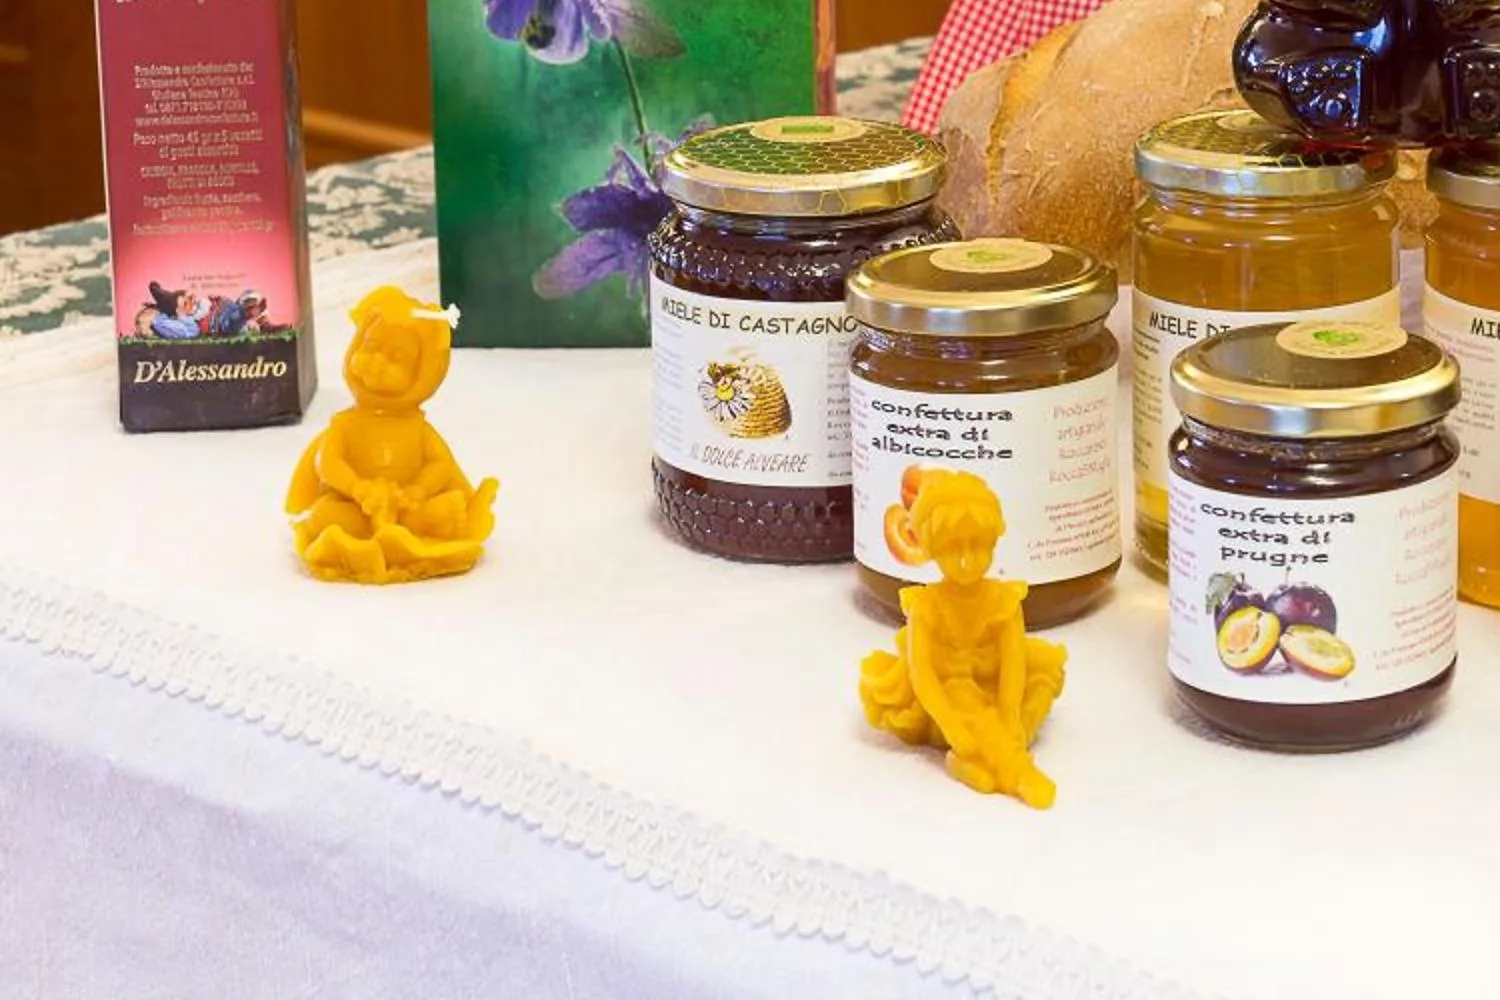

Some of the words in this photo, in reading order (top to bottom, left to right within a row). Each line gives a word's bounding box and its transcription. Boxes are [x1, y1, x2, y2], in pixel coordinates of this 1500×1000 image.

[662, 297, 702, 325] MIELE
[709, 310, 731, 330] DI
[739, 314, 858, 335] CASTAGNO
[1150, 311, 1198, 340] MIELE
[134, 356, 287, 383] D'Alessandro
[871, 399, 1013, 422] confettura
[887, 423, 951, 441] extra
[961, 427, 989, 443] di
[871, 436, 1013, 460] albicocche
[1200, 502, 1356, 525] confettura
[1218, 527, 1288, 546] extra
[1302, 530, 1332, 545] di
[1220, 546, 1328, 567] prugne
